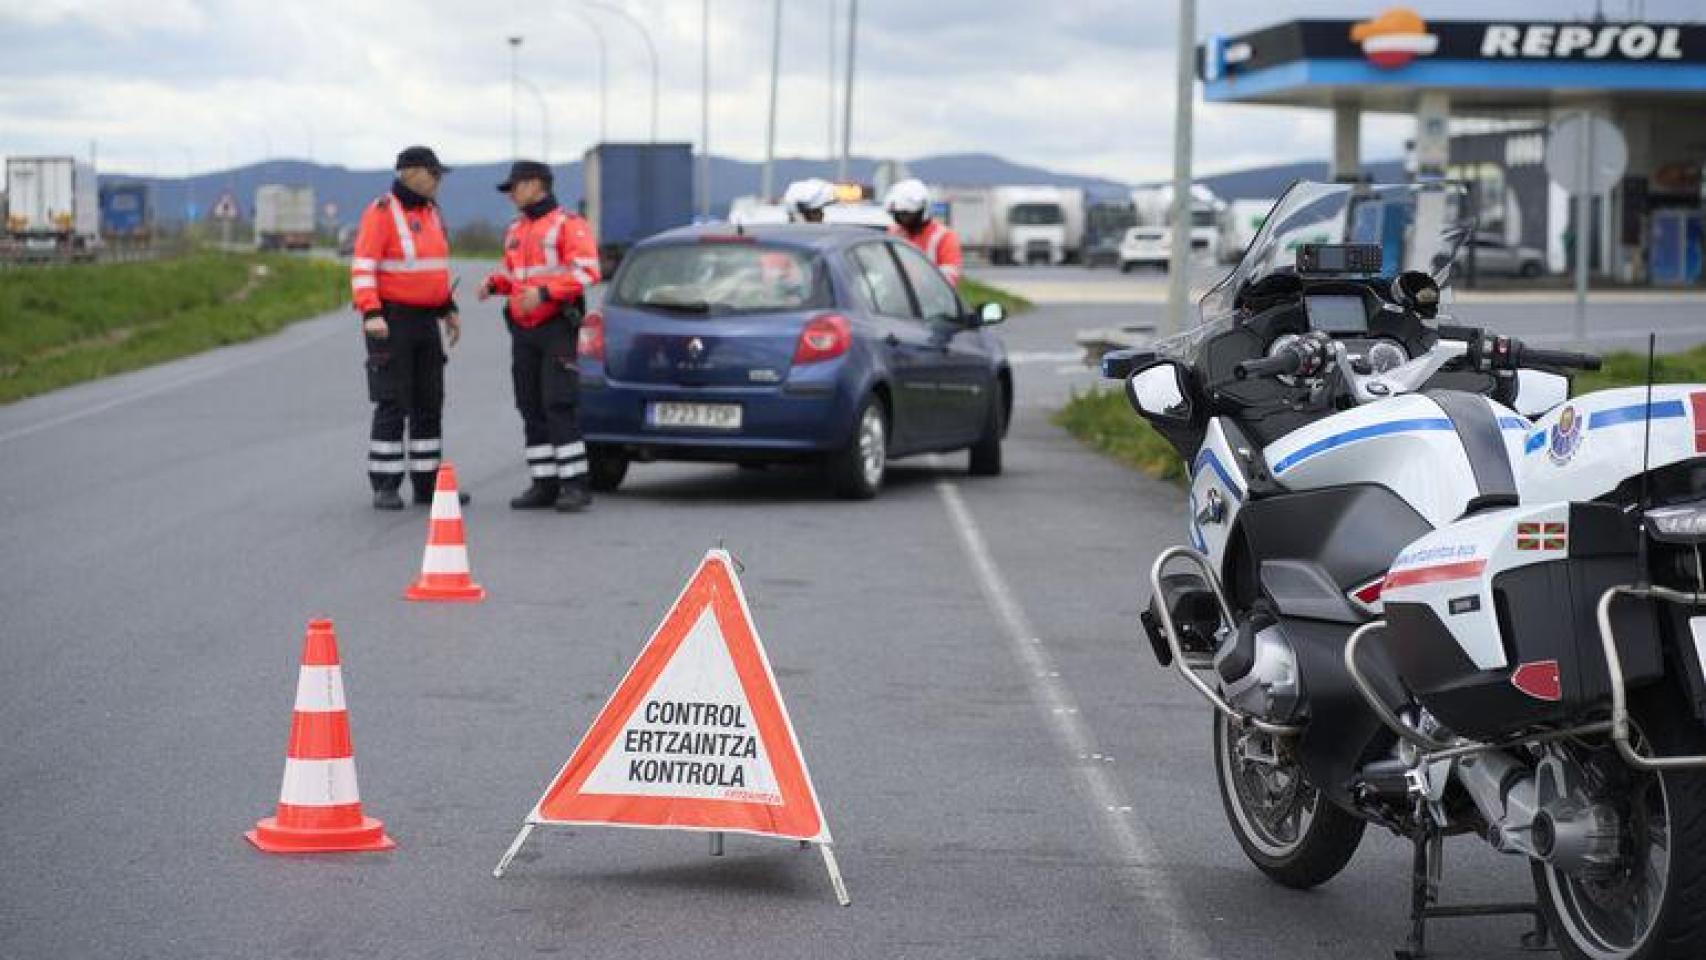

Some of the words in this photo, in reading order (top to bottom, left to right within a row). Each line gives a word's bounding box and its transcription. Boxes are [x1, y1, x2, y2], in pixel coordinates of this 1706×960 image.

[1481, 25, 1682, 58] REPSOL
[645, 700, 746, 728] CONTROL
[624, 729, 757, 759] ERTZAINTZA
[628, 759, 745, 788] KONTROLA
